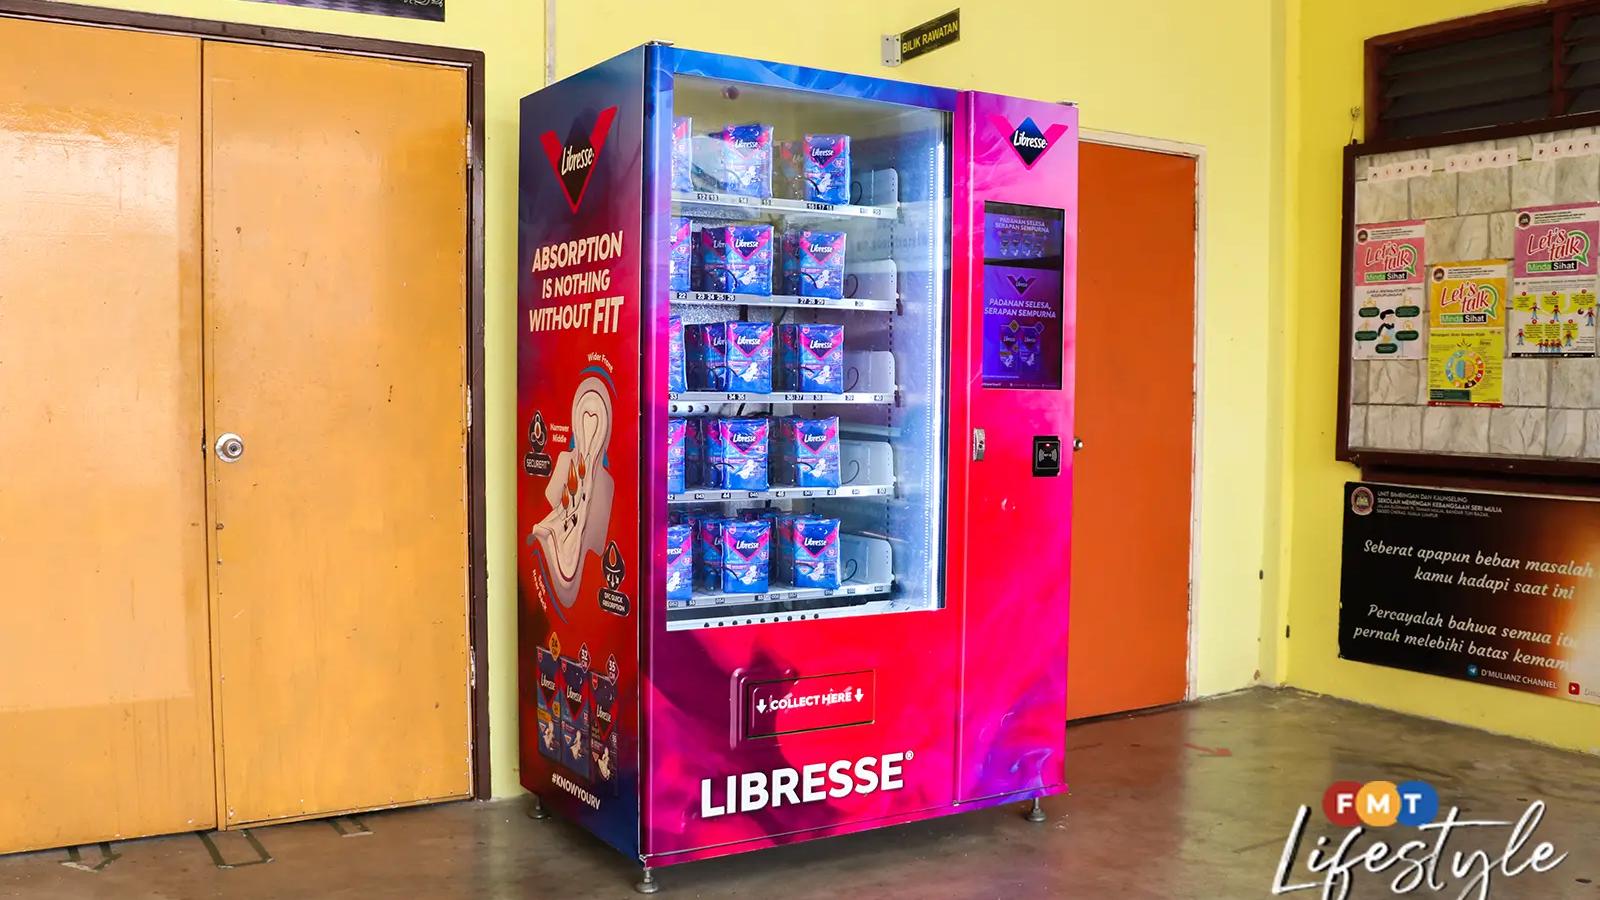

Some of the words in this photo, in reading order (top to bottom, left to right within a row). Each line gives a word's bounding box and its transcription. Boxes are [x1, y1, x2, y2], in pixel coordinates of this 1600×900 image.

[902, 36, 921, 54] BILIK
[922, 20, 959, 46] RAWATAN
[1013, 130, 1046, 149] Libresse
[561, 145, 594, 176] Libresse
[811, 149, 835, 158] Libresse
[532, 230, 623, 273] ABSORPTION
[735, 239, 759, 249] Libresse
[810, 243, 834, 253] Libresse
[1527, 228, 1567, 255] Let's
[1549, 235, 1581, 261] talk
[1365, 242, 1397, 266] Let's
[1384, 248, 1410, 272] talk
[1553, 261, 1575, 270] Sihat
[542, 278, 553, 299] IS
[554, 269, 611, 298] NOTHING
[1386, 272, 1406, 280] Sihat
[989, 298, 1024, 308] PADANAN
[1025, 301, 1051, 310] SELESA,
[1440, 281, 1478, 307] Let's
[1461, 289, 1490, 314] talk
[529, 303, 592, 332] WITHOUT
[593, 296, 625, 334] FIT
[984, 307, 1017, 317] SERAPAN
[1018, 309, 1056, 319] SEMPURNA
[1464, 313, 1485, 322] Sihat
[737, 335, 761, 345] Libresse
[809, 339, 832, 349] Libresse
[732, 433, 756, 443] Libresse
[804, 433, 827, 443] Libresse
[1401, 499, 1432, 508] MENENGAH
[1432, 502, 1470, 510] KEBANGSAAN
[736, 541, 759, 550] Libresse
[804, 538, 827, 547] Libresse
[1364, 539, 1413, 557] Seberat
[1417, 548, 1470, 564] apapun
[1475, 550, 1520, 569] beban
[1524, 560, 1594, 578] masalah
[1414, 566, 1453, 584] kamu
[1457, 571, 1510, 593] hadapi
[1514, 580, 1548, 596] saat
[1552, 584, 1575, 600] ini
[1367, 604, 1443, 628] Percayalah
[1448, 615, 1497, 636] bahwa
[1501, 628, 1551, 645] semua
[1353, 626, 1400, 642] pernah
[1404, 633, 1463, 653] melebihi
[1467, 641, 1509, 660] batas
[1481, 669, 1521, 683] D'MULIANZ
[1522, 675, 1558, 689] CHANNEL
[770, 695, 820, 711] COLLECT
[822, 691, 852, 705] HERE
[551, 773, 601, 810] #KNOWYOURV
